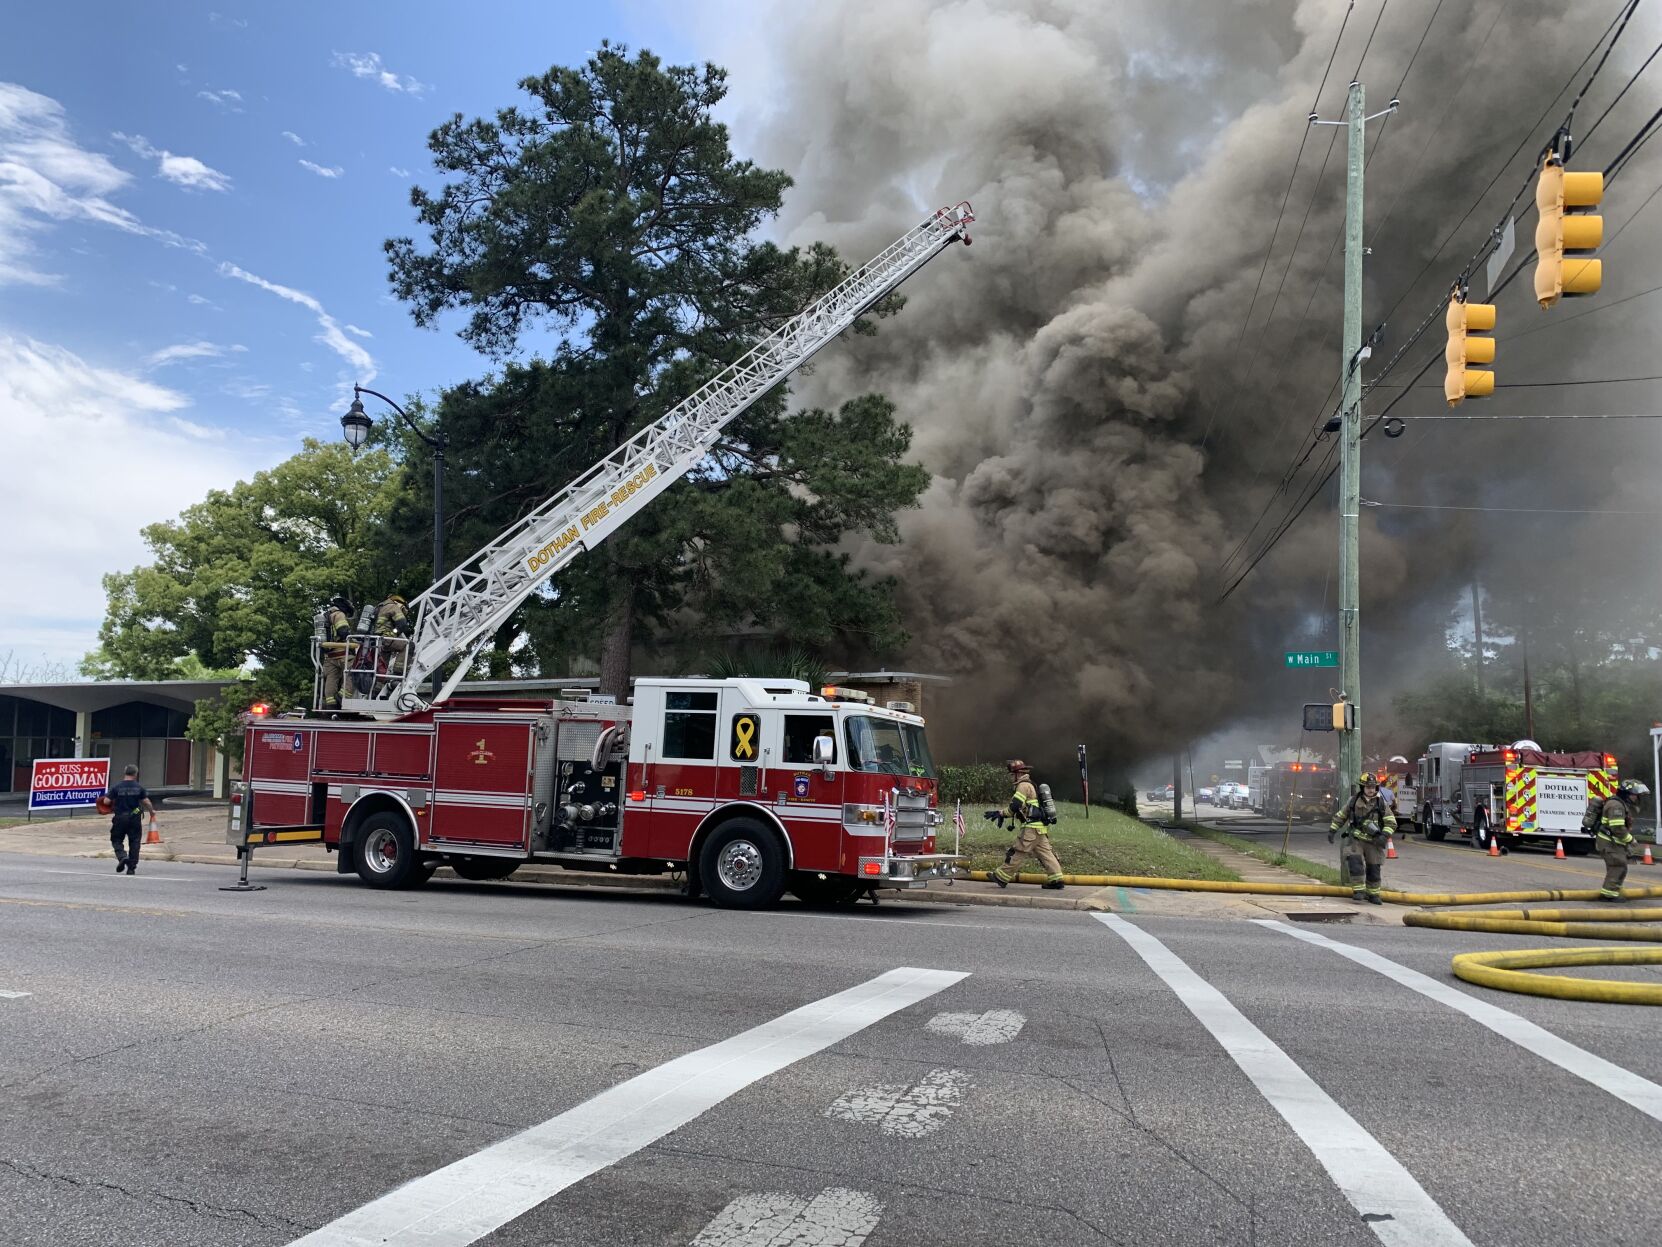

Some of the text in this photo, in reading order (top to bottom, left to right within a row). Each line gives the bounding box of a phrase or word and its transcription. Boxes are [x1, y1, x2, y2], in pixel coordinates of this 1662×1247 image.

[528, 463, 658, 572] DOTHAN FIRE-RESCUE
[1297, 654, 1320, 665] Main
[59, 764, 82, 774] RUSS
[34, 772, 106, 788] GOODMAN
[675, 788, 693, 796] 5178
[1545, 784, 1579, 792] DOTHAN
[35, 790, 102, 801] District Attorney
[1539, 792, 1585, 801] FIRE-RESCUE
